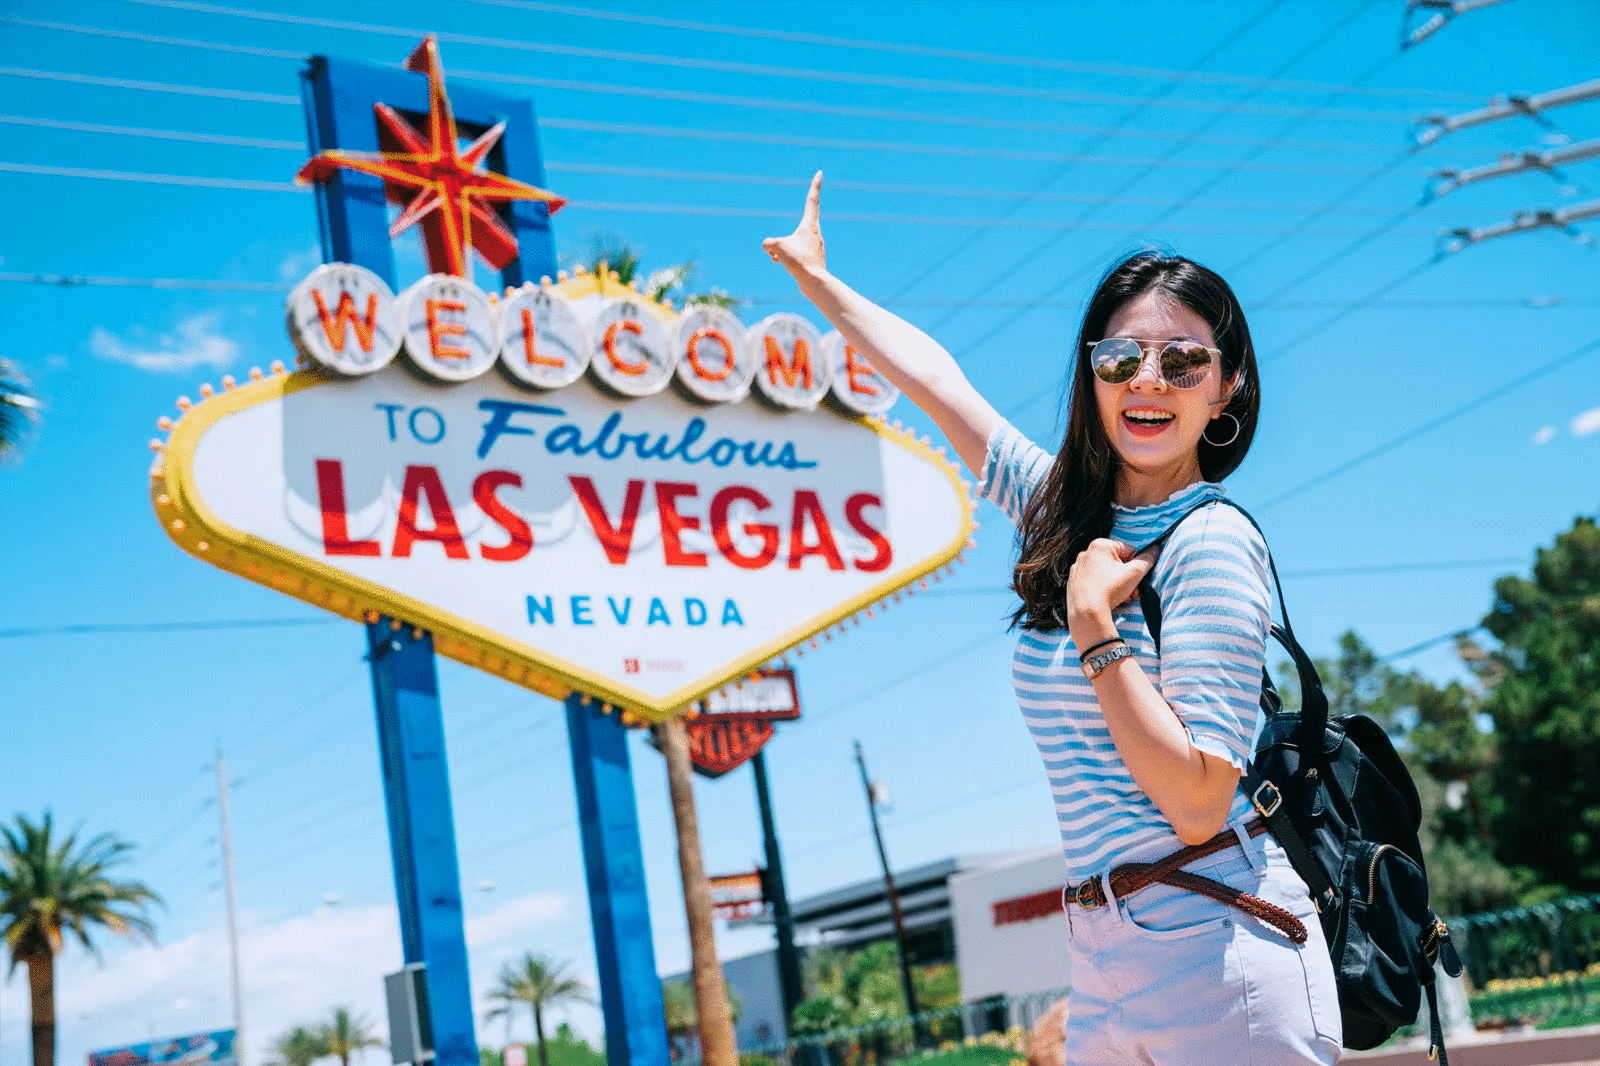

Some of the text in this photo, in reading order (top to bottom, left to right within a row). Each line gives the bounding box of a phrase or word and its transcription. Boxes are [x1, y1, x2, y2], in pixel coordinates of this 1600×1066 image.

[311, 288, 879, 396] WELCOME
[375, 400, 819, 470] TO Fabulous
[315, 459, 893, 573] LAS VEGAS
[527, 596, 745, 626] NEVADA
